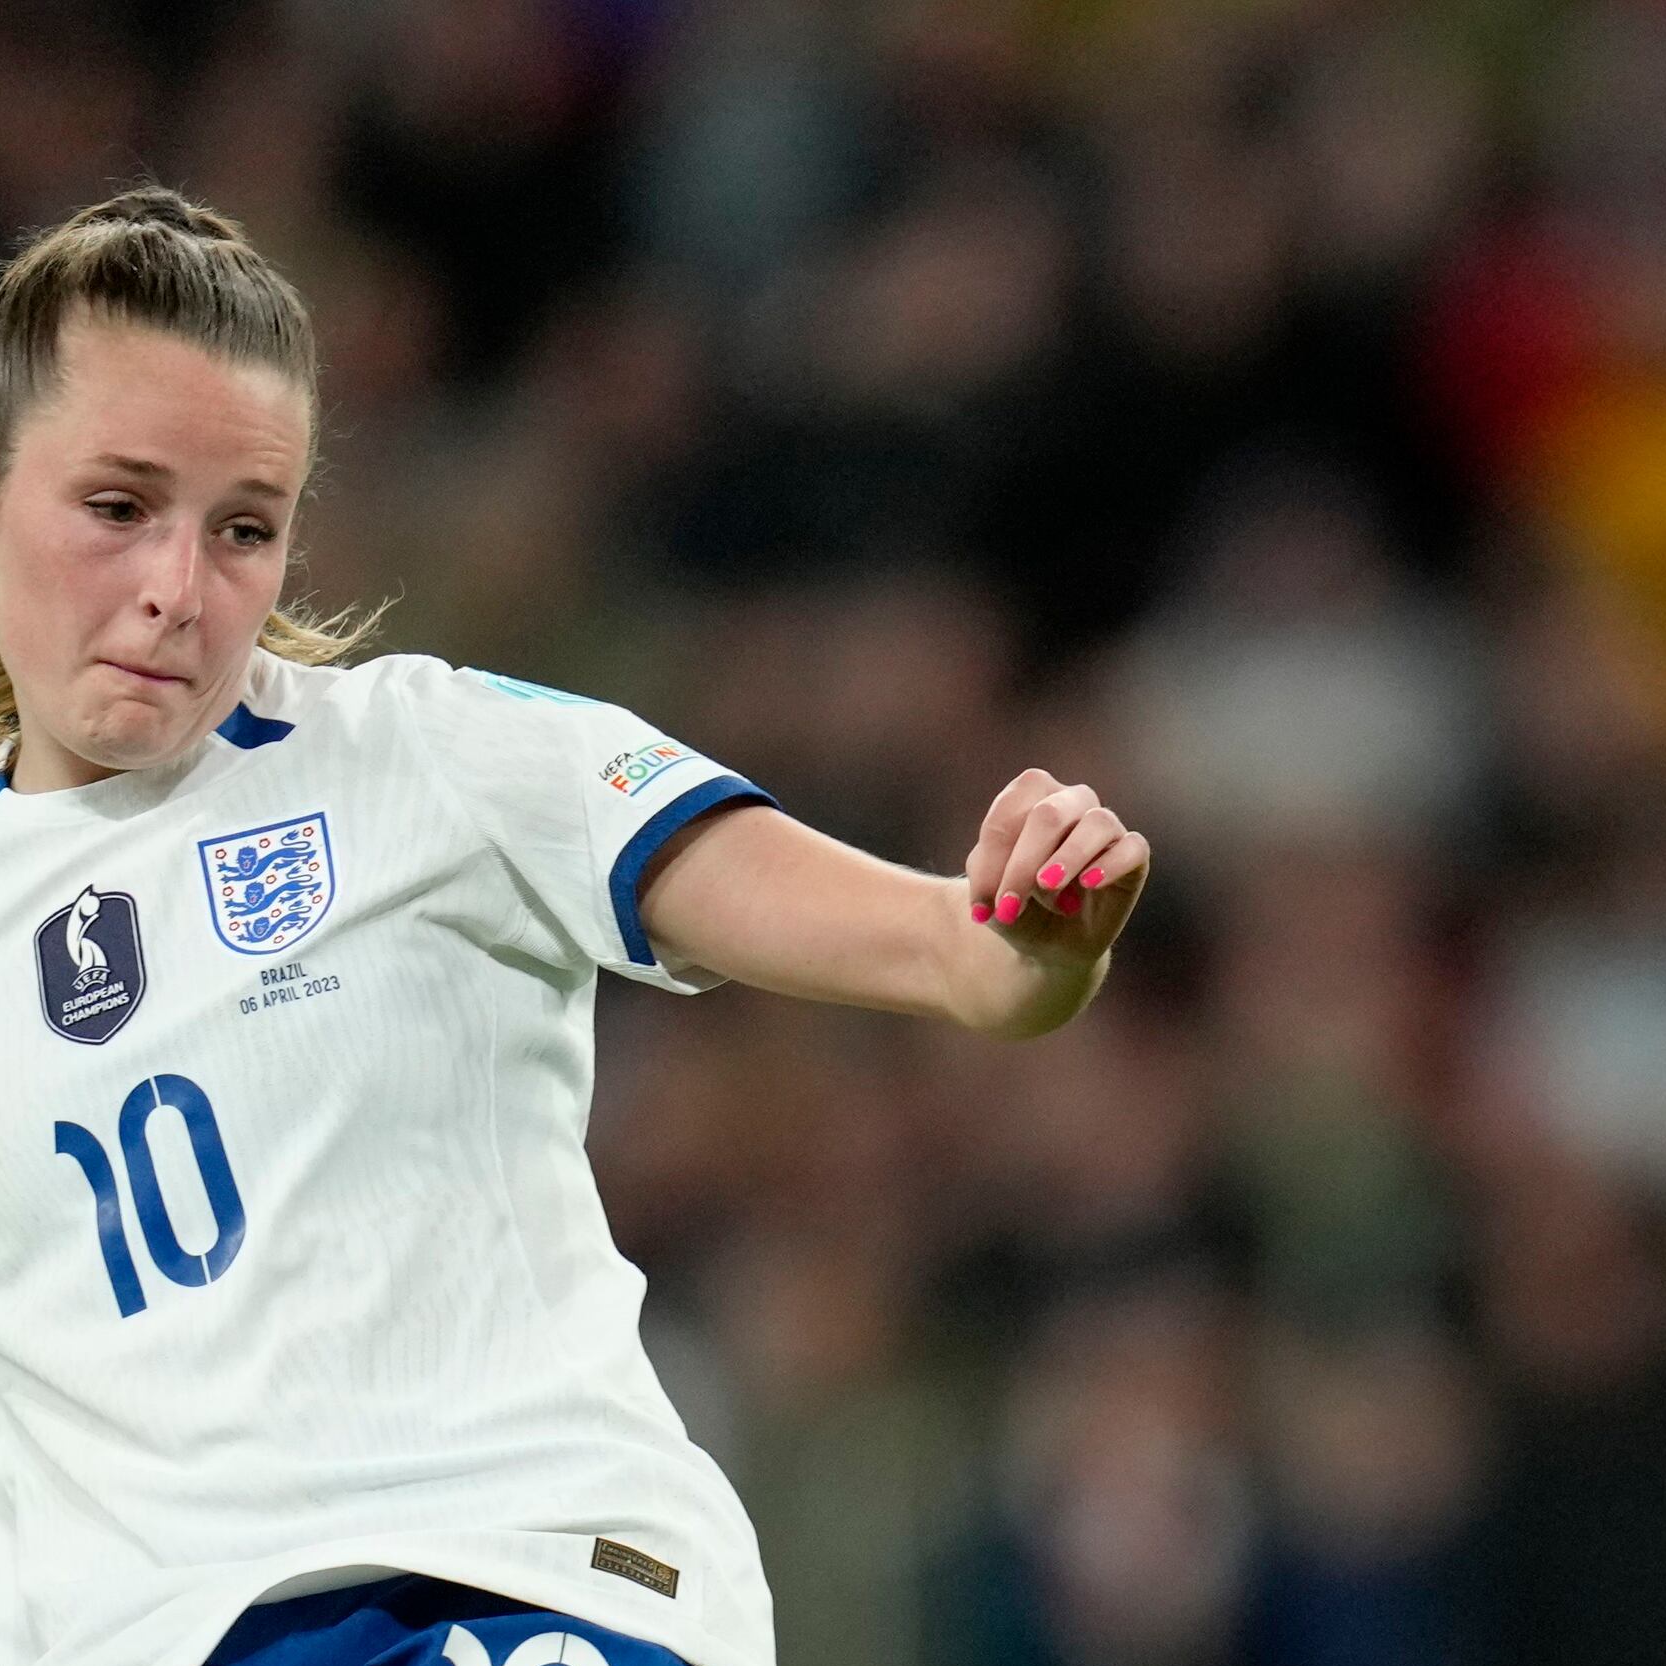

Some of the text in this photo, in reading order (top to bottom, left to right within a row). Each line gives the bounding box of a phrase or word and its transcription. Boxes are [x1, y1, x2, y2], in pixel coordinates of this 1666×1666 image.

[598, 752, 633, 781] UEFA
[74, 972, 108, 990] UEFA
[261, 962, 307, 986] BRAZIL
[61, 992, 130, 1026] CHAMPIONS
[62, 981, 124, 1012] EUROPEAN
[239, 975, 341, 1014] 06 APRIL 2023
[54, 1073, 246, 1319] 10
